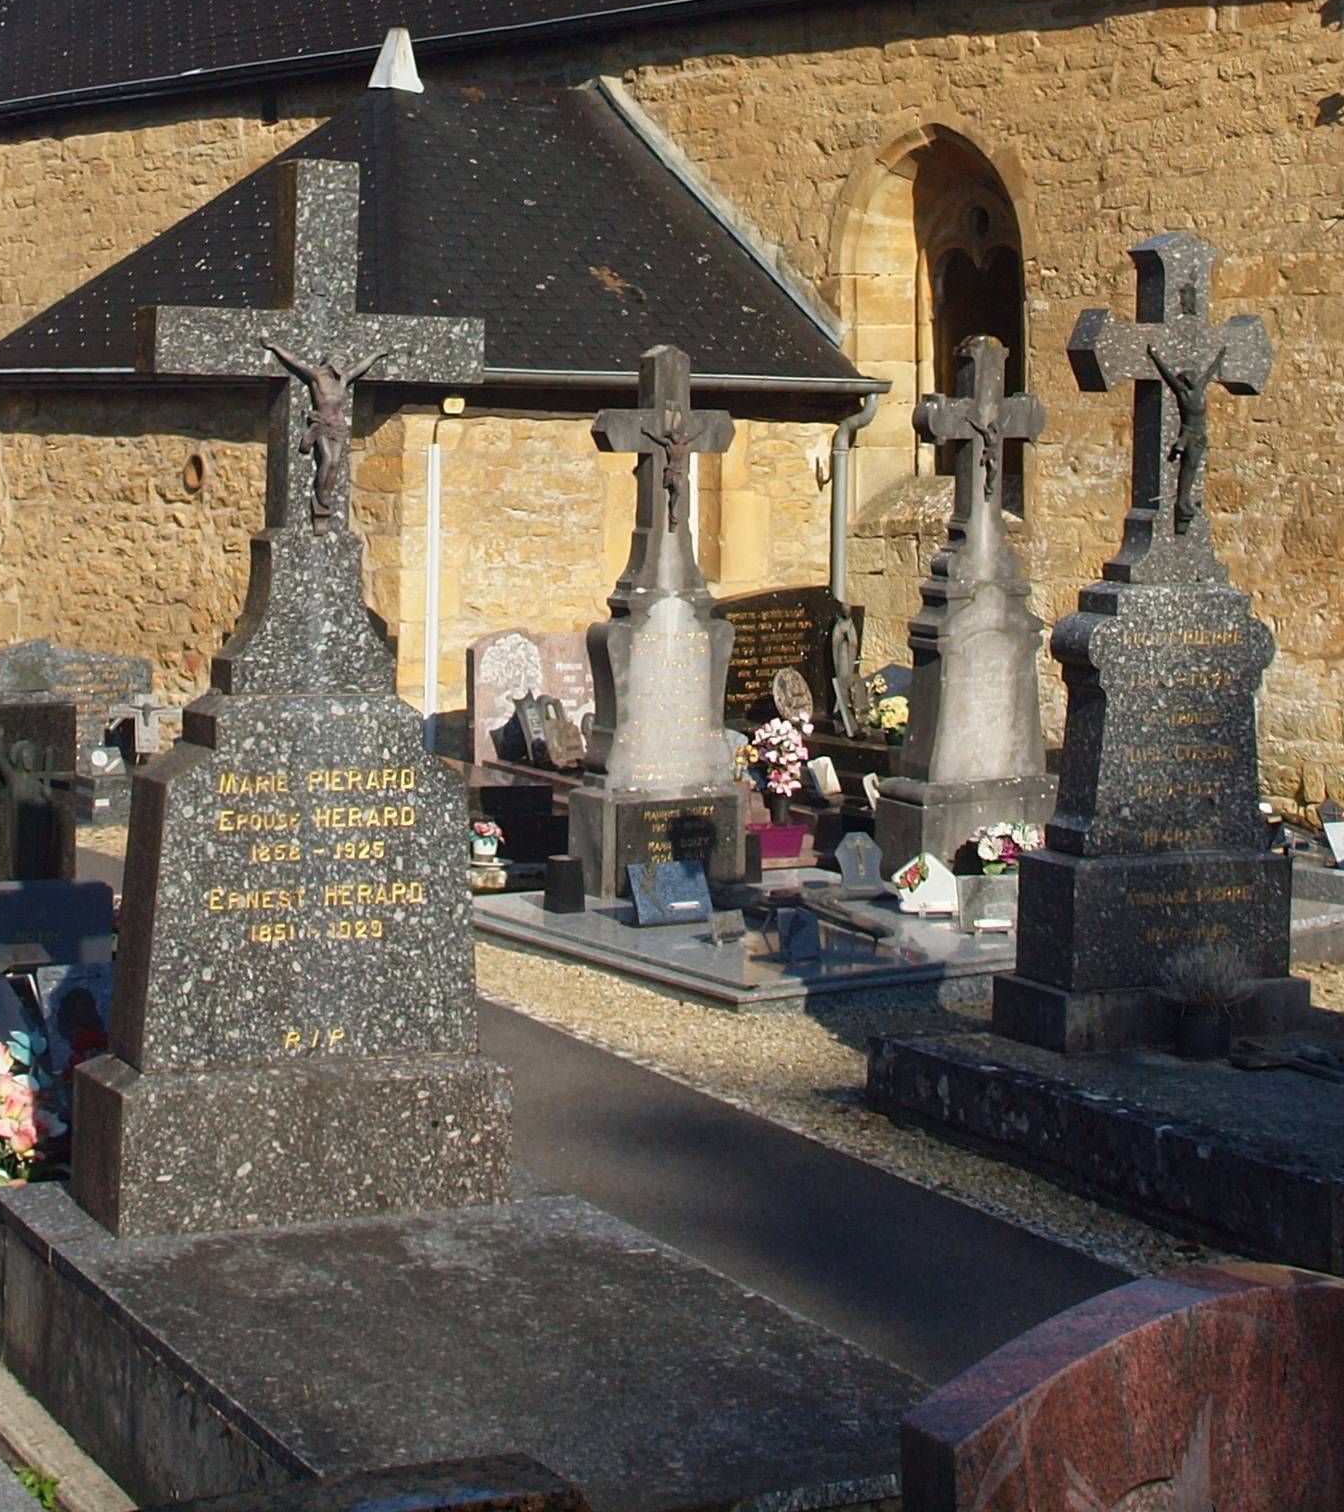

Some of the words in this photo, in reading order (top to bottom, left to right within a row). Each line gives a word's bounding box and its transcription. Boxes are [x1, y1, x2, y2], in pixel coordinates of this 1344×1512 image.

[218, 772, 289, 795] MARIE
[307, 769, 417, 793] PIERARD
[218, 810, 301, 832] EPOUSE
[315, 805, 416, 829] HERARD
[333, 840, 386, 861] 1925
[209, 890, 306, 912] ERNEST
[323, 881, 424, 907] HERARD
